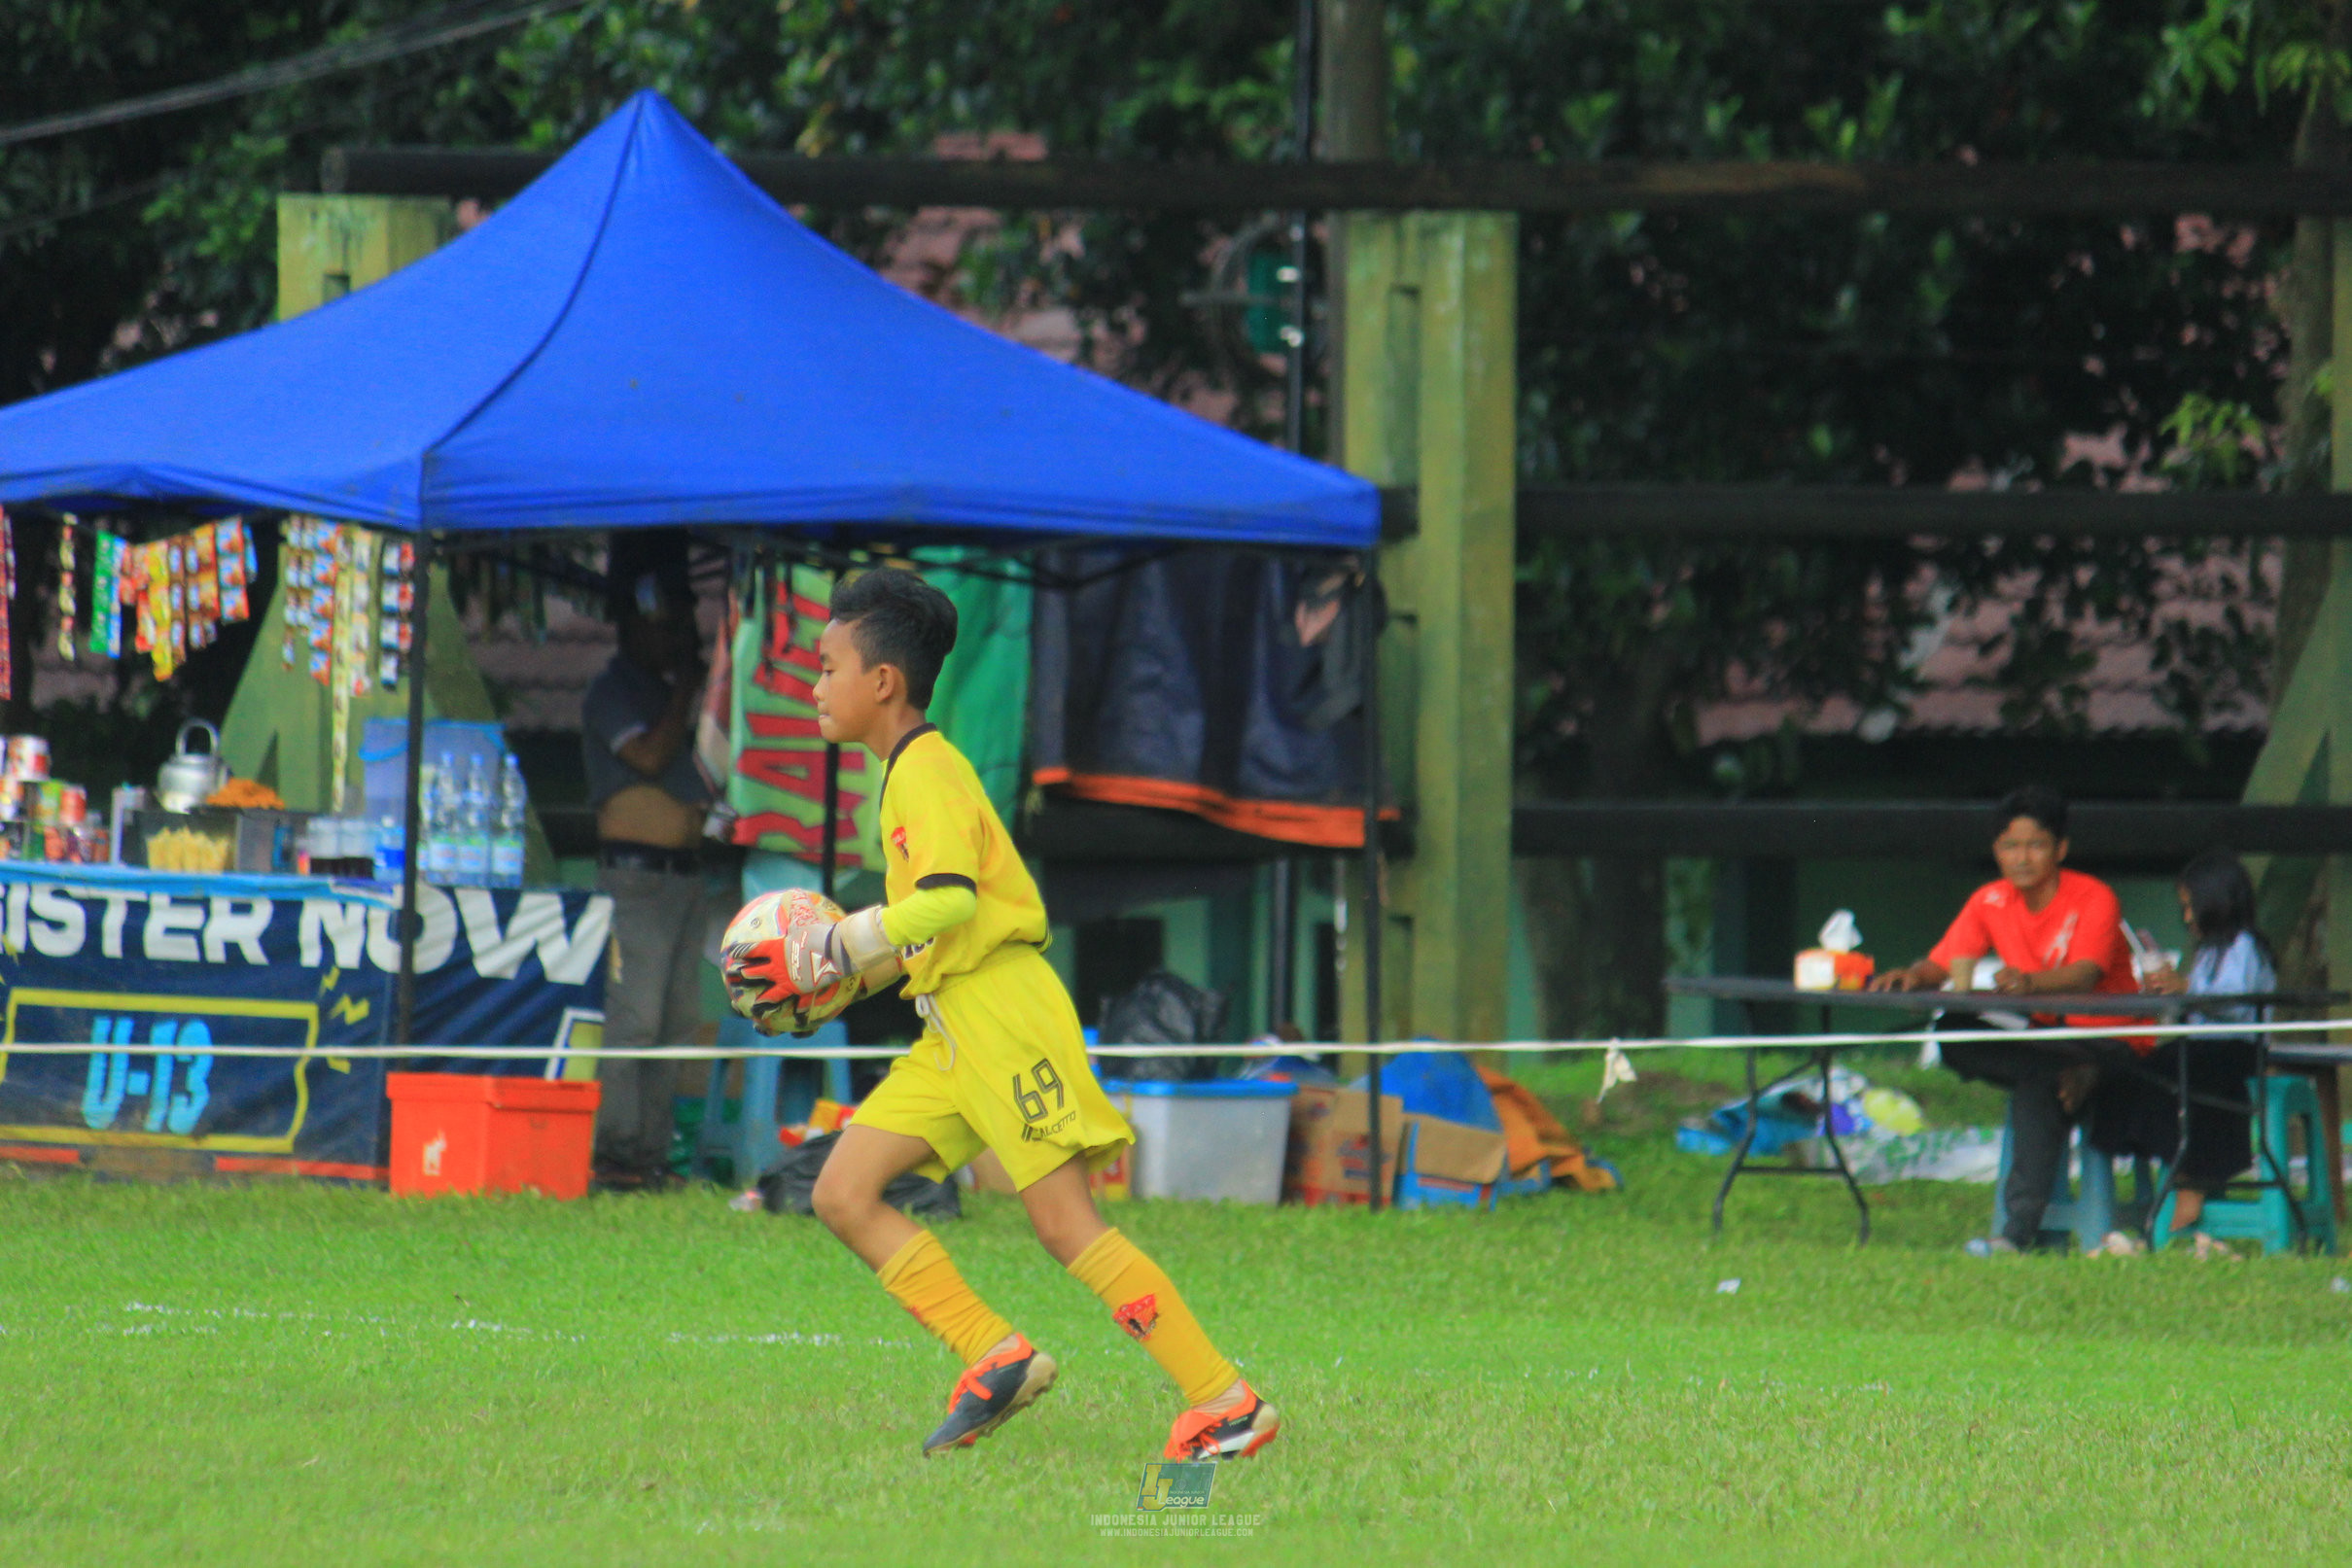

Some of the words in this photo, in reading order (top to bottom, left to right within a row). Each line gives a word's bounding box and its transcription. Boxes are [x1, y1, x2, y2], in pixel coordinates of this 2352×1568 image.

[0, 881, 273, 965] ISTER
[299, 883, 614, 985] NOW
[83, 1016, 213, 1135] U-13
[1012, 1058, 1065, 1124] 69
